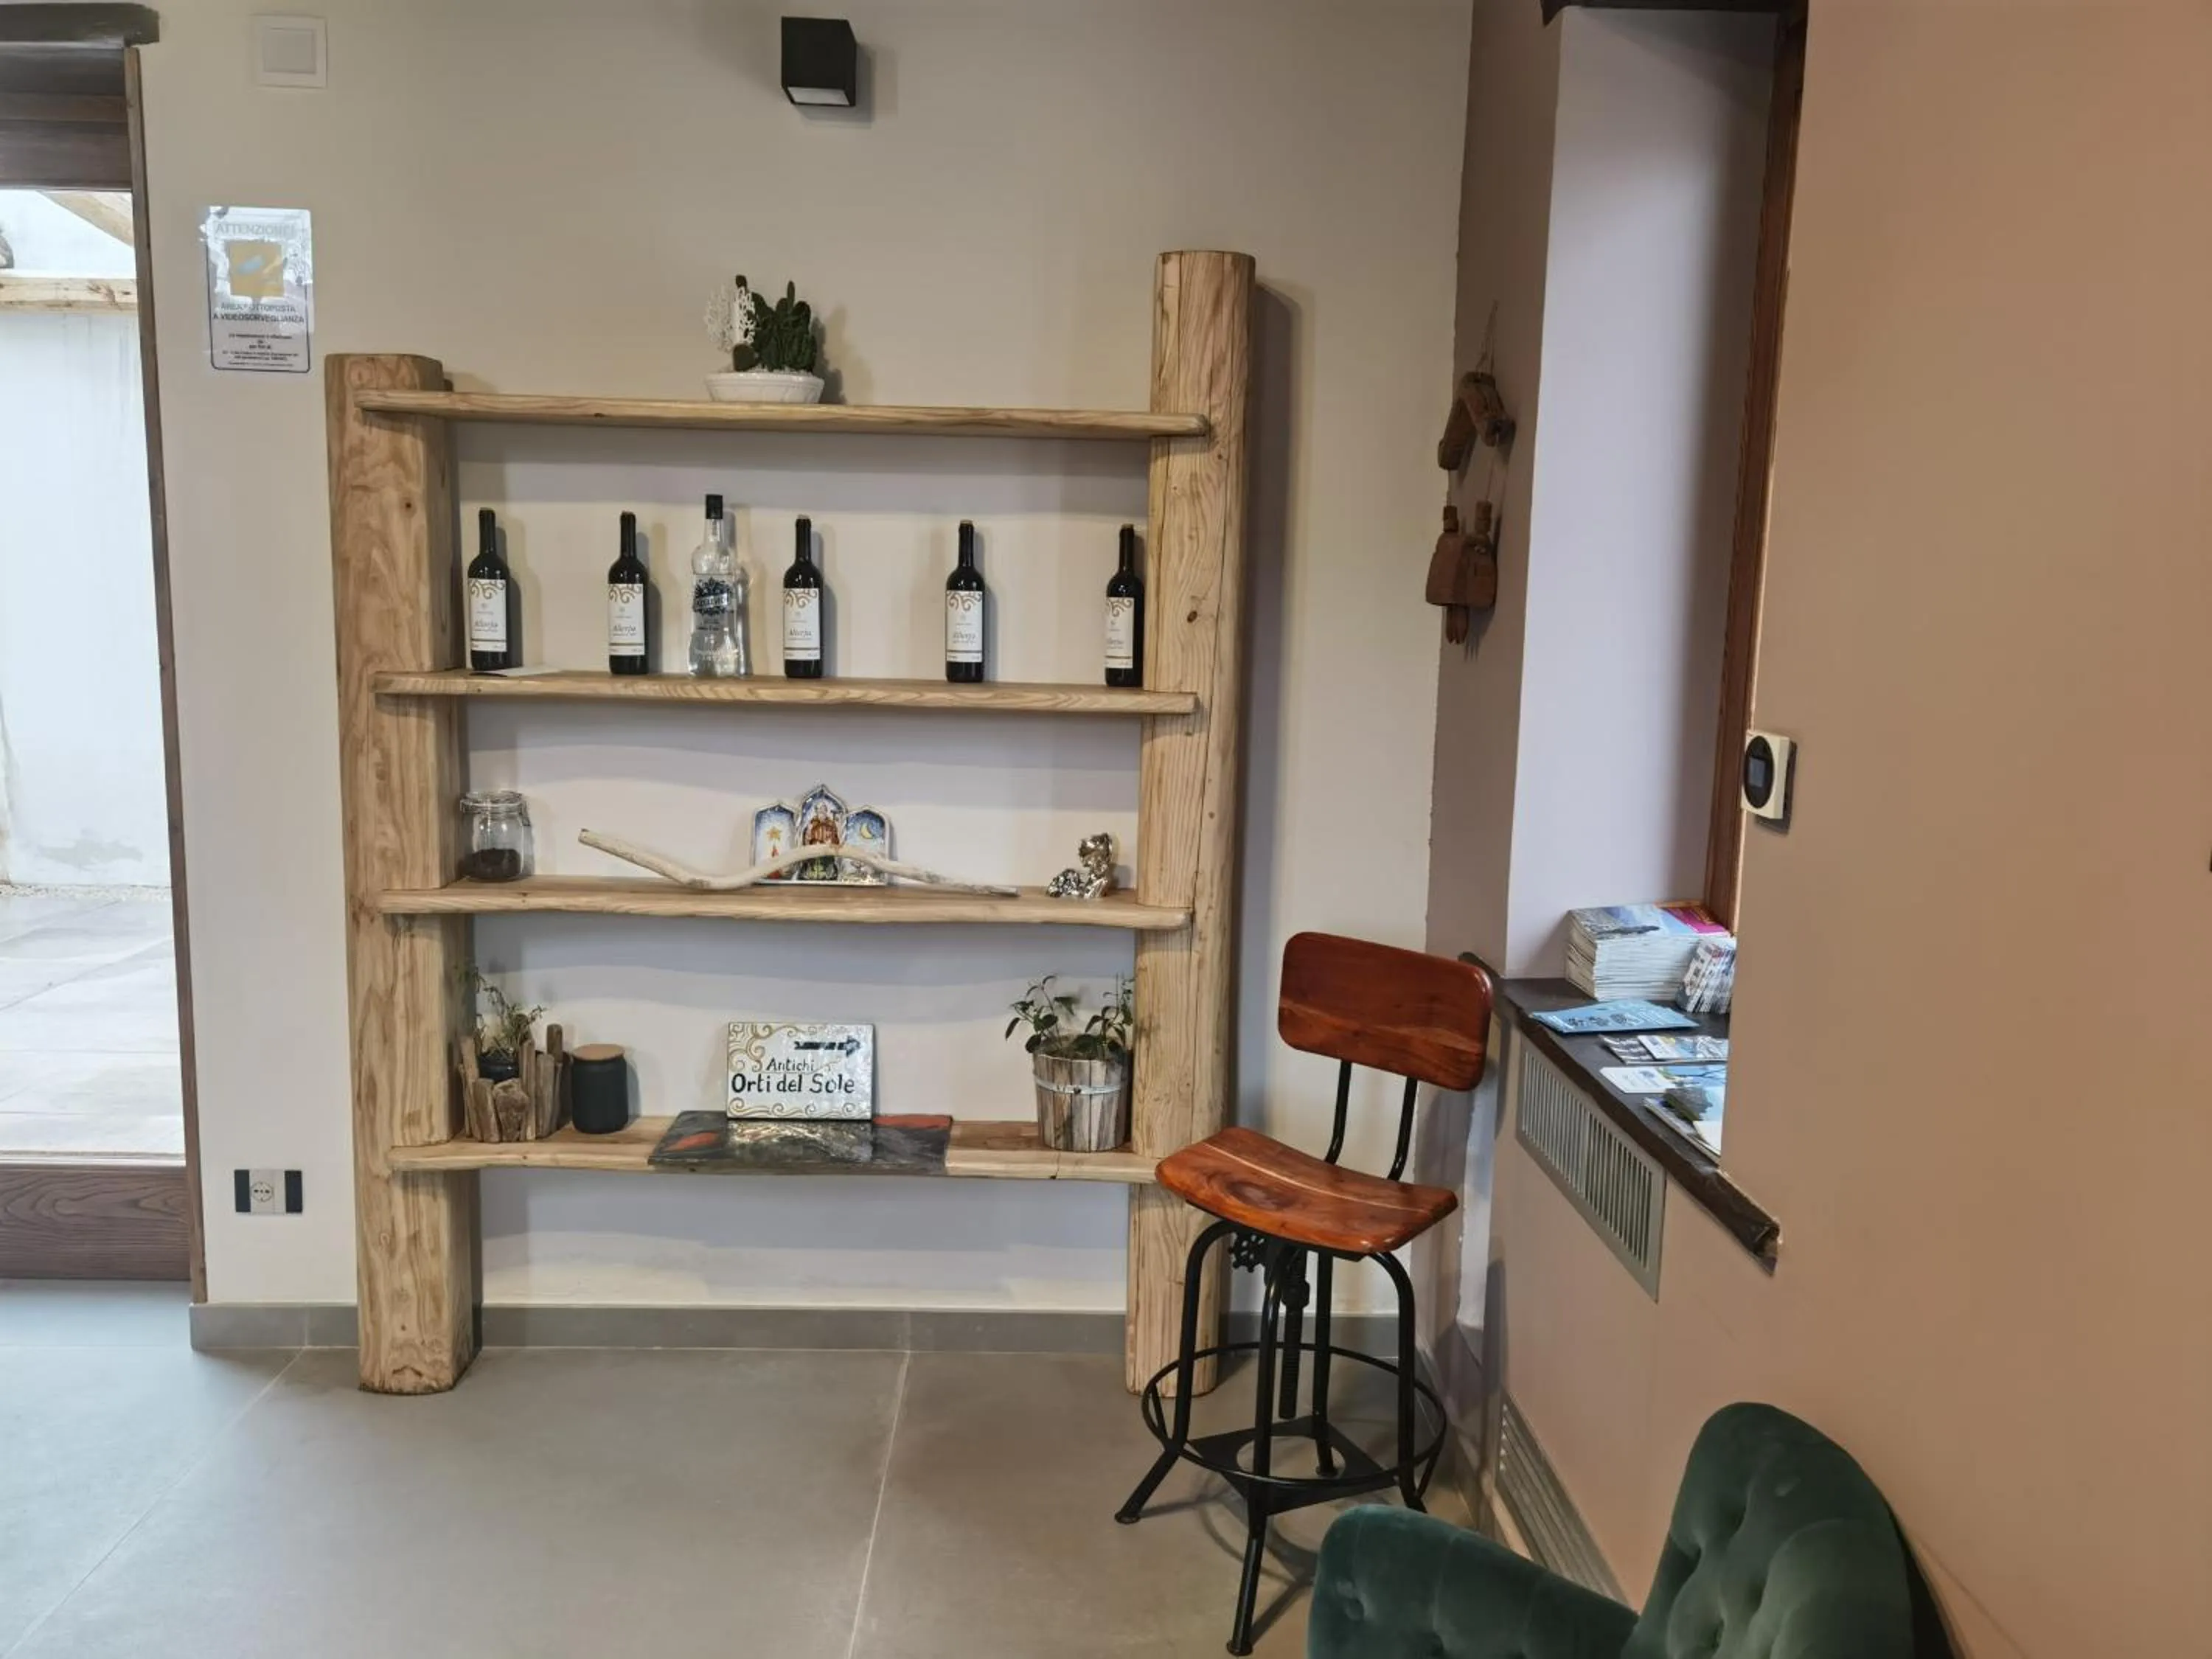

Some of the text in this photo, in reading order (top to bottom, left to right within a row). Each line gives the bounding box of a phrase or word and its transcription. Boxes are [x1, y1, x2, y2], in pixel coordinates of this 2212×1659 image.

[765, 1057, 815, 1071] Antichi
[731, 1072, 855, 1094] Orti del Sole
